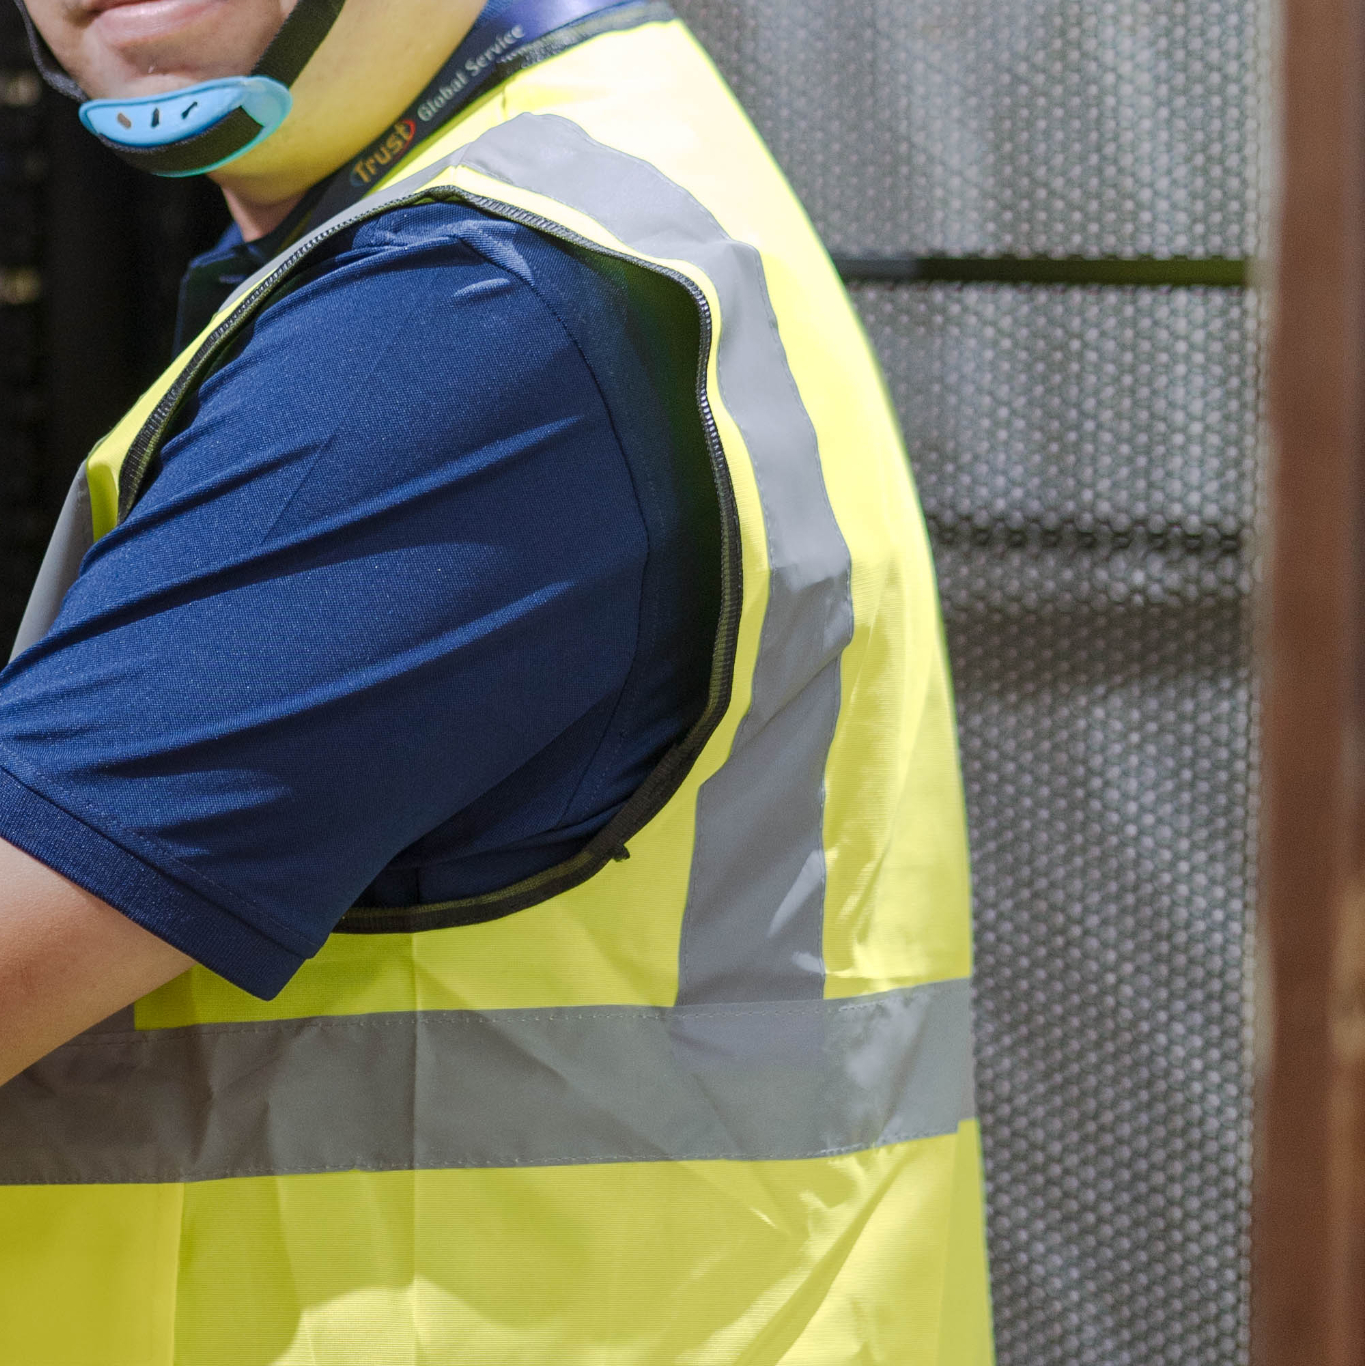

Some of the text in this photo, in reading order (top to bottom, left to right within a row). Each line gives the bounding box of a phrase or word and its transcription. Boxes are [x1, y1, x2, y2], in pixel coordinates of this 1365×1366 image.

[354, 24, 526, 184] Trust Global Service
